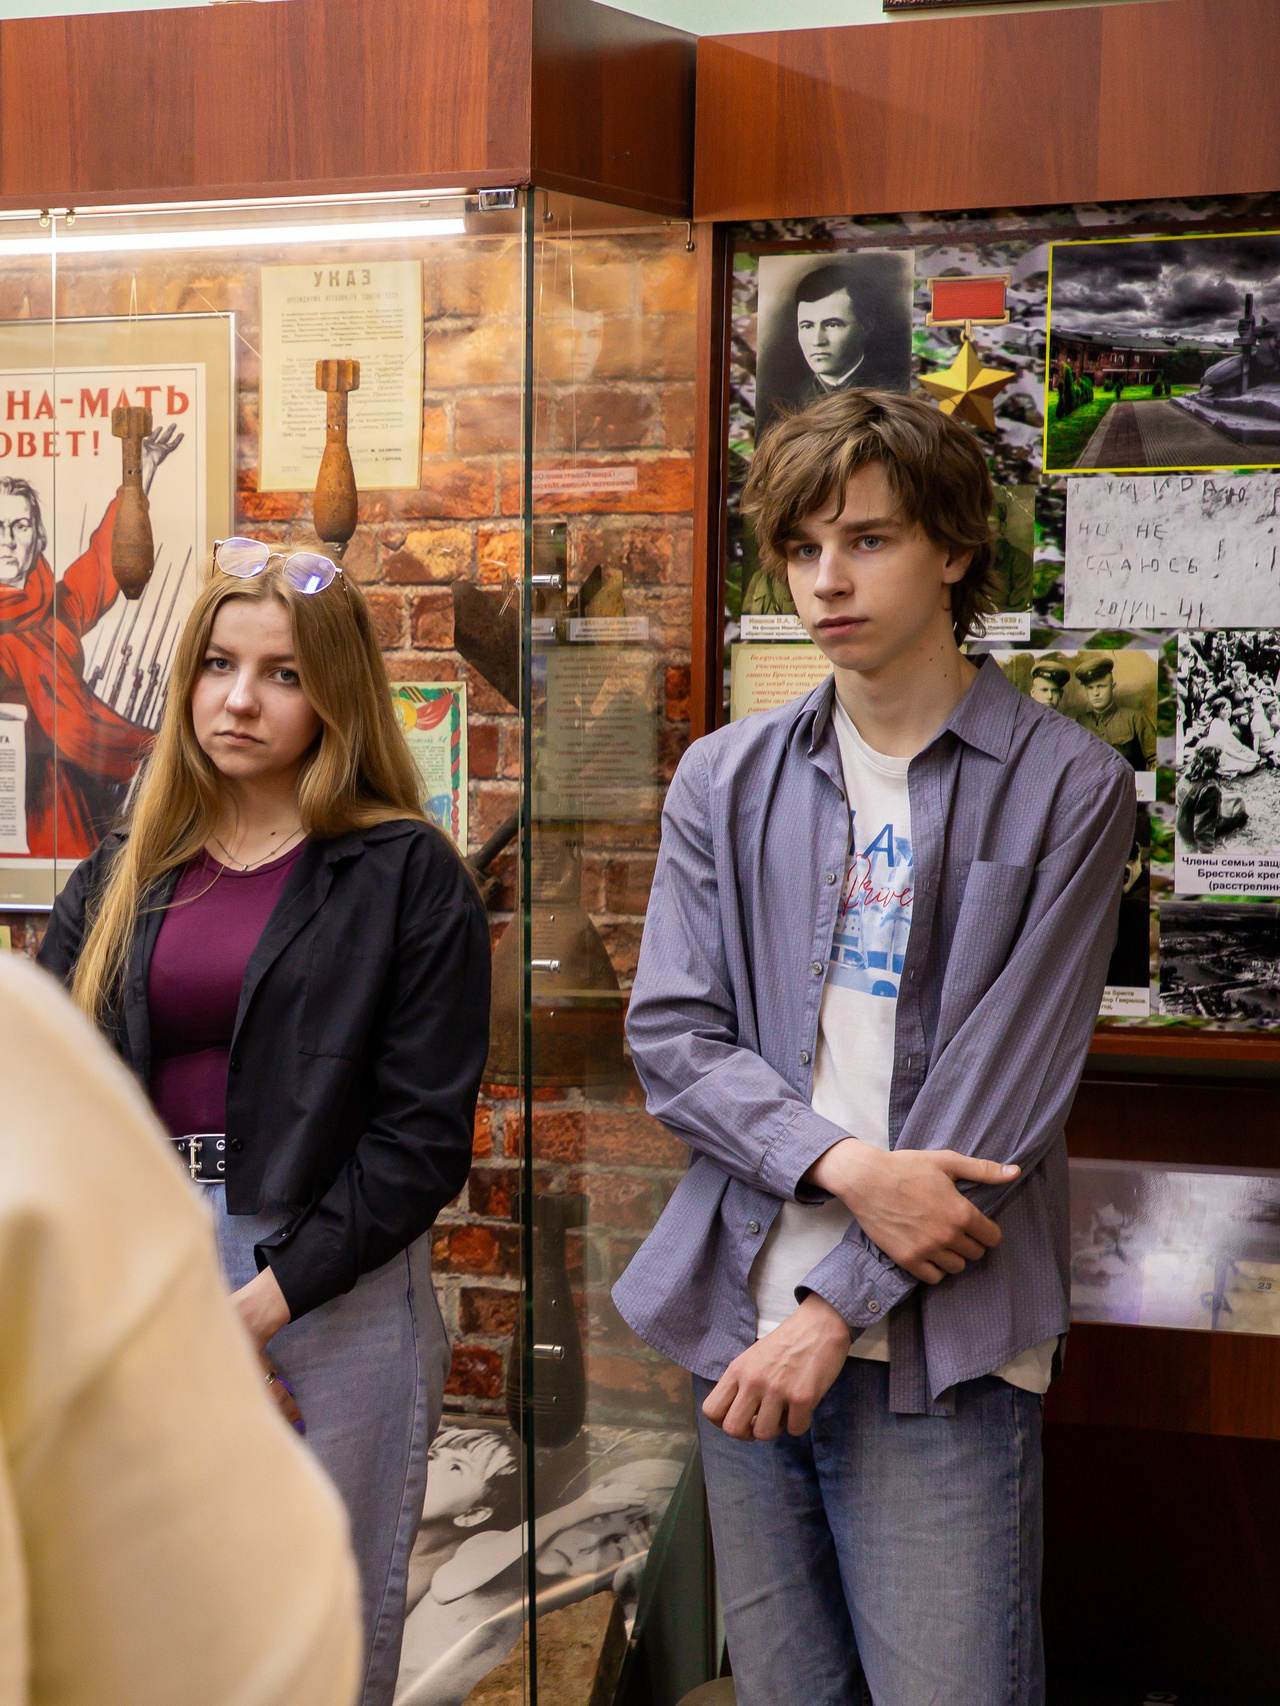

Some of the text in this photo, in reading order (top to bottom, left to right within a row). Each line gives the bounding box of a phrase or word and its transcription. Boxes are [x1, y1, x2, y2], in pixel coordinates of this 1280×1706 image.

[314, 269, 371, 287] УКАЗ
[1136, 523, 1168, 541] НЕ
[1182, 856, 1218, 866] Члены
[1221, 858, 1255, 867] семьи
[1197, 868, 1254, 879] Брестской
[1258, 1282, 1272, 1290] 23
